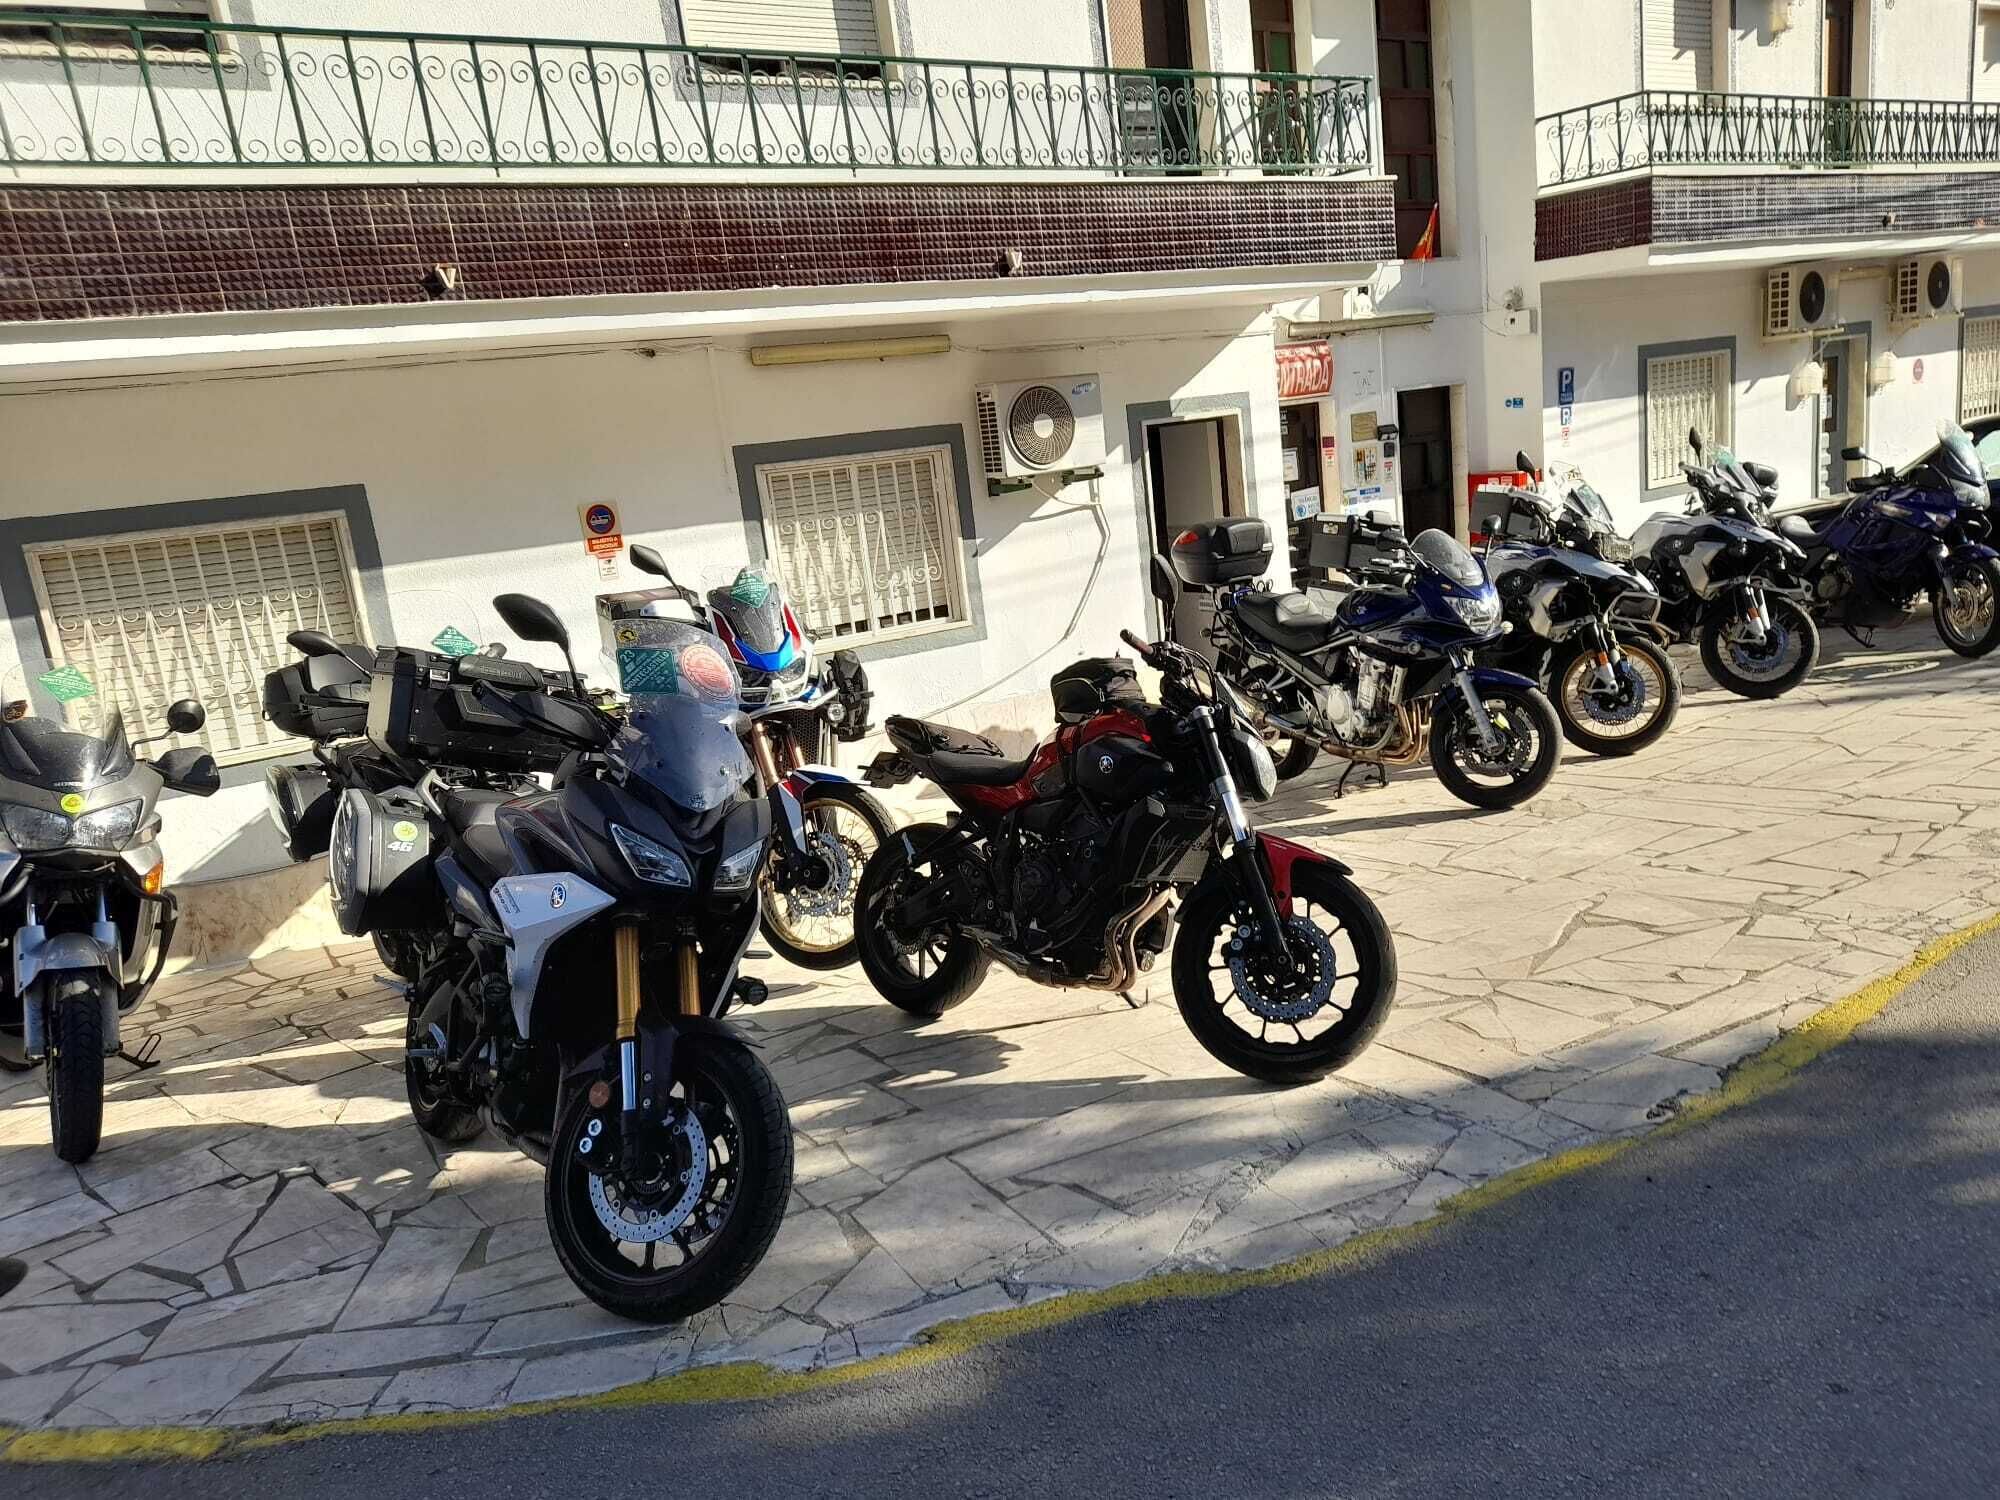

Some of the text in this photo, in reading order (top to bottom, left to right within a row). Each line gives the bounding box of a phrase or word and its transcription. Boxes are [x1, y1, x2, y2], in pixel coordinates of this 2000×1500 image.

[1562, 370, 1572, 392] P
[620, 650, 635, 663] 23
[387, 841, 414, 852] 46
